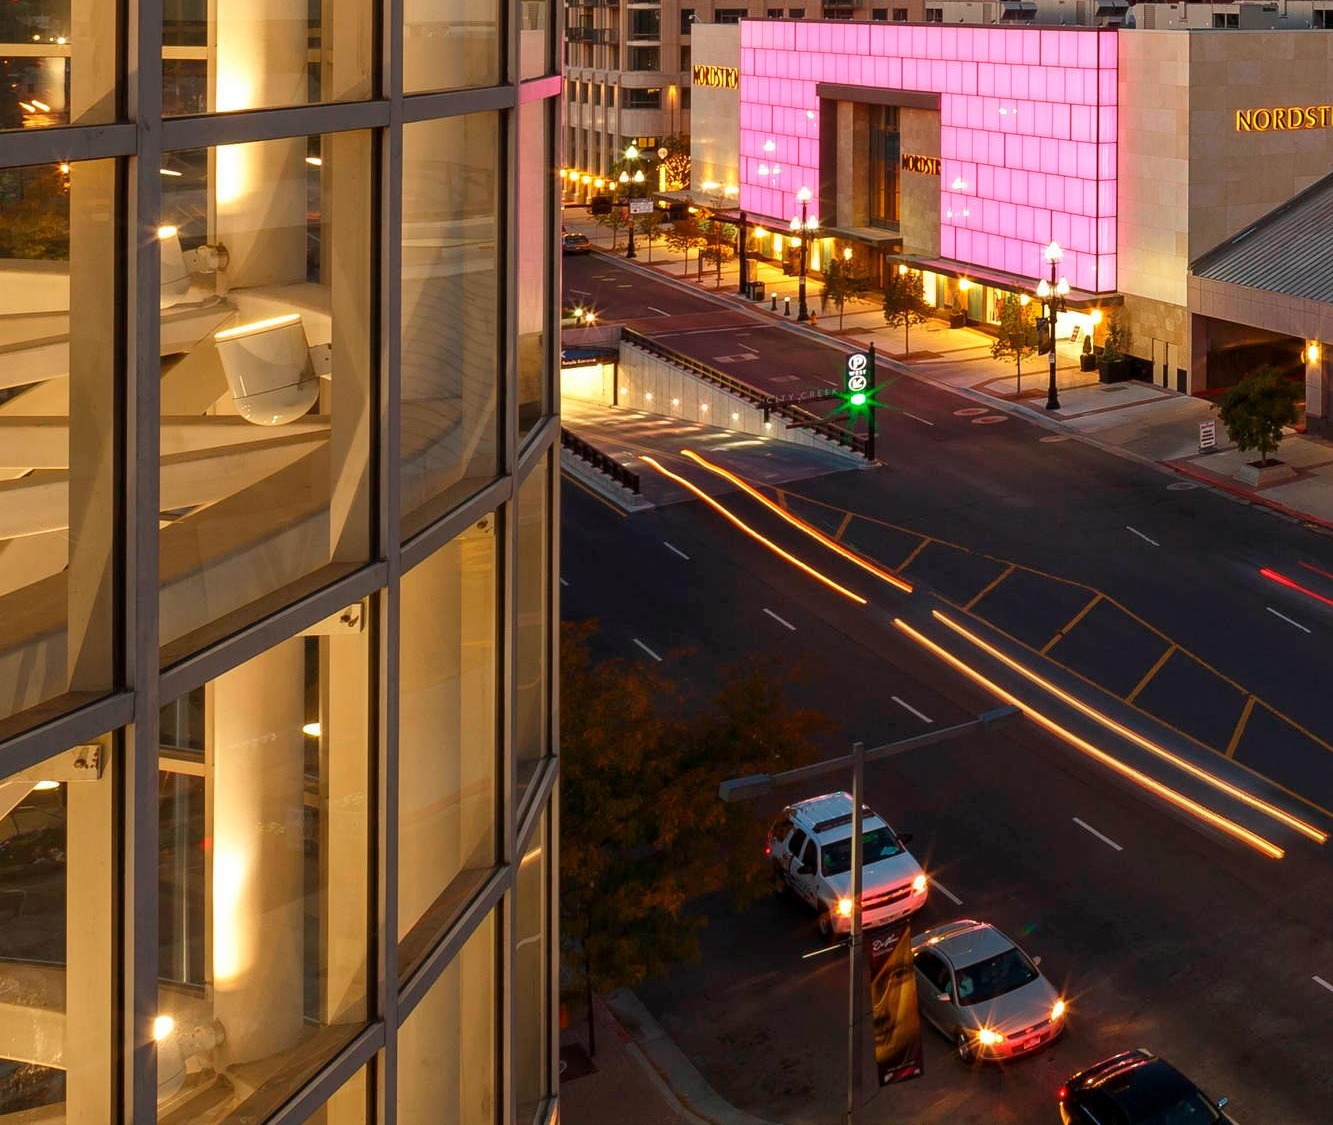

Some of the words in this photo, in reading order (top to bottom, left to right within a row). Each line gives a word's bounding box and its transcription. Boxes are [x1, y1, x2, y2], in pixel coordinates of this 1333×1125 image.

[693, 63, 739, 90] NORDSTRO
[766, 394, 794, 405] CITY
[800, 387, 839, 400] CREEK
